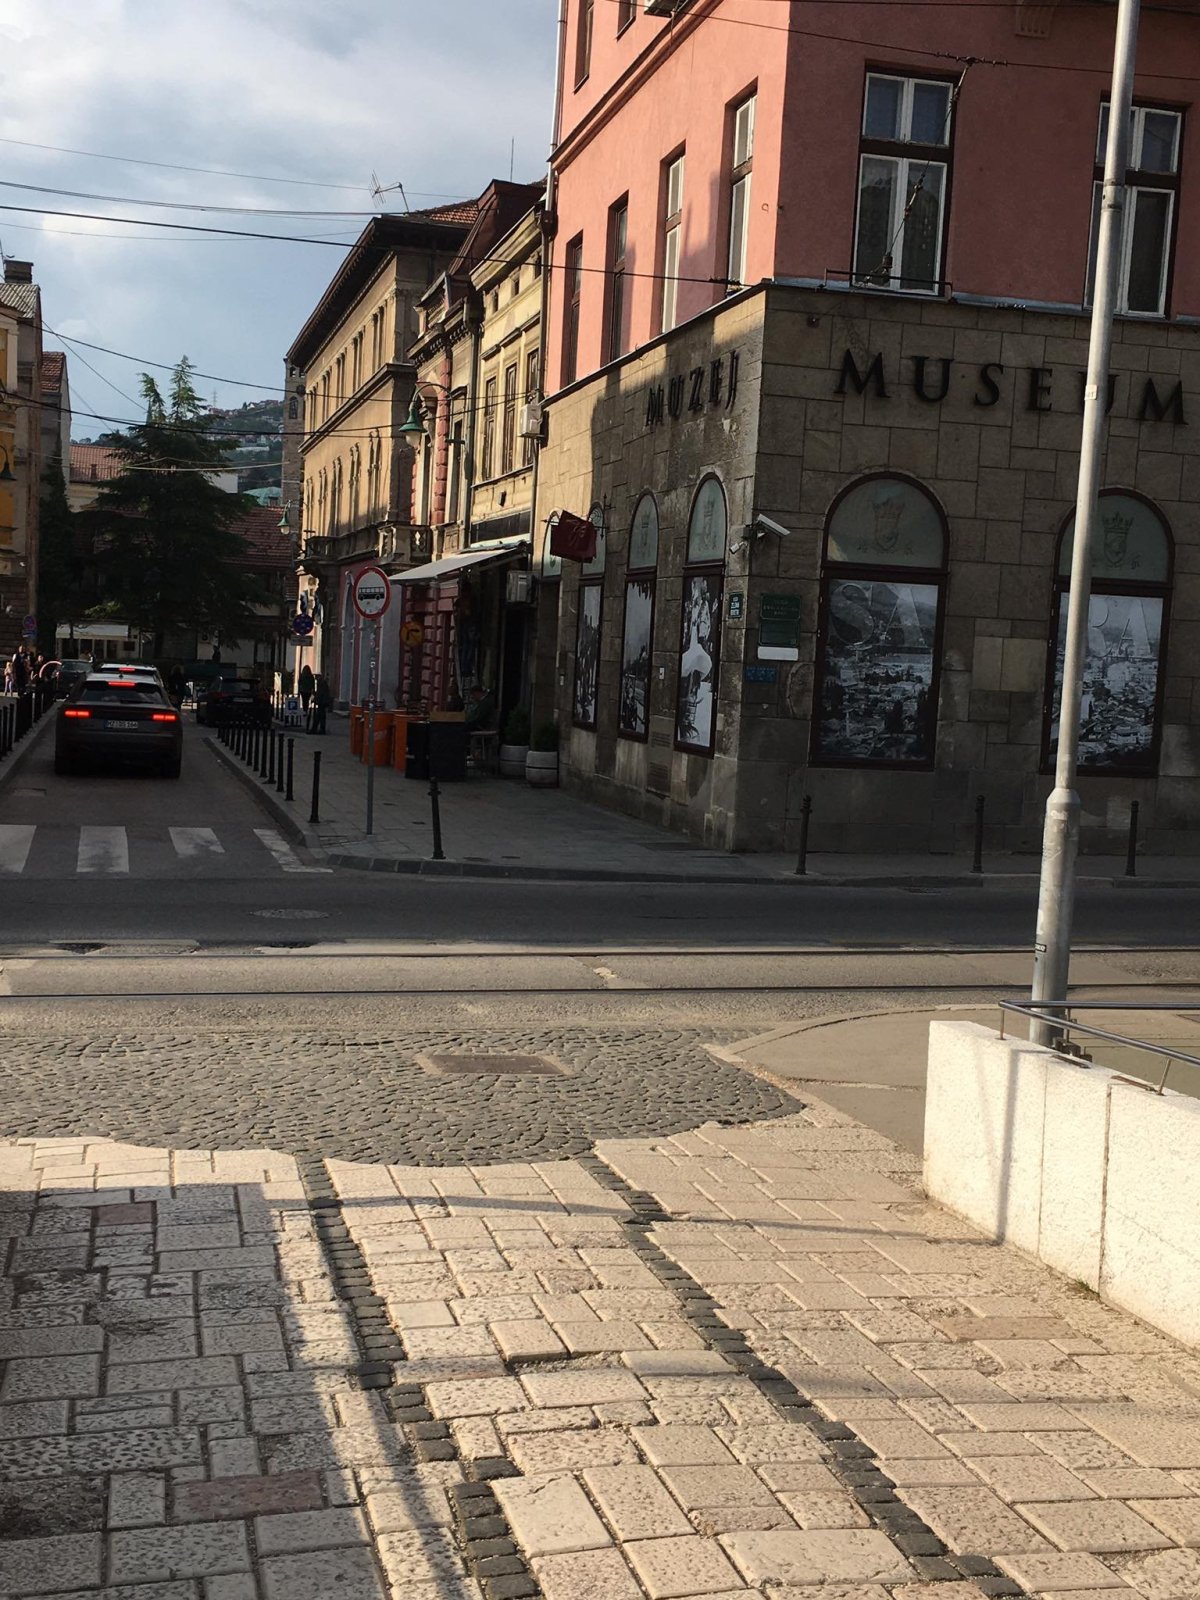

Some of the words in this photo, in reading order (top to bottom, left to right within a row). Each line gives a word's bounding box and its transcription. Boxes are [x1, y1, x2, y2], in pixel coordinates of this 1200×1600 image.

[645, 350, 739, 427] MUZEJ
[835, 348, 1187, 424] MUSEUM
[830, 582, 924, 650] SA
